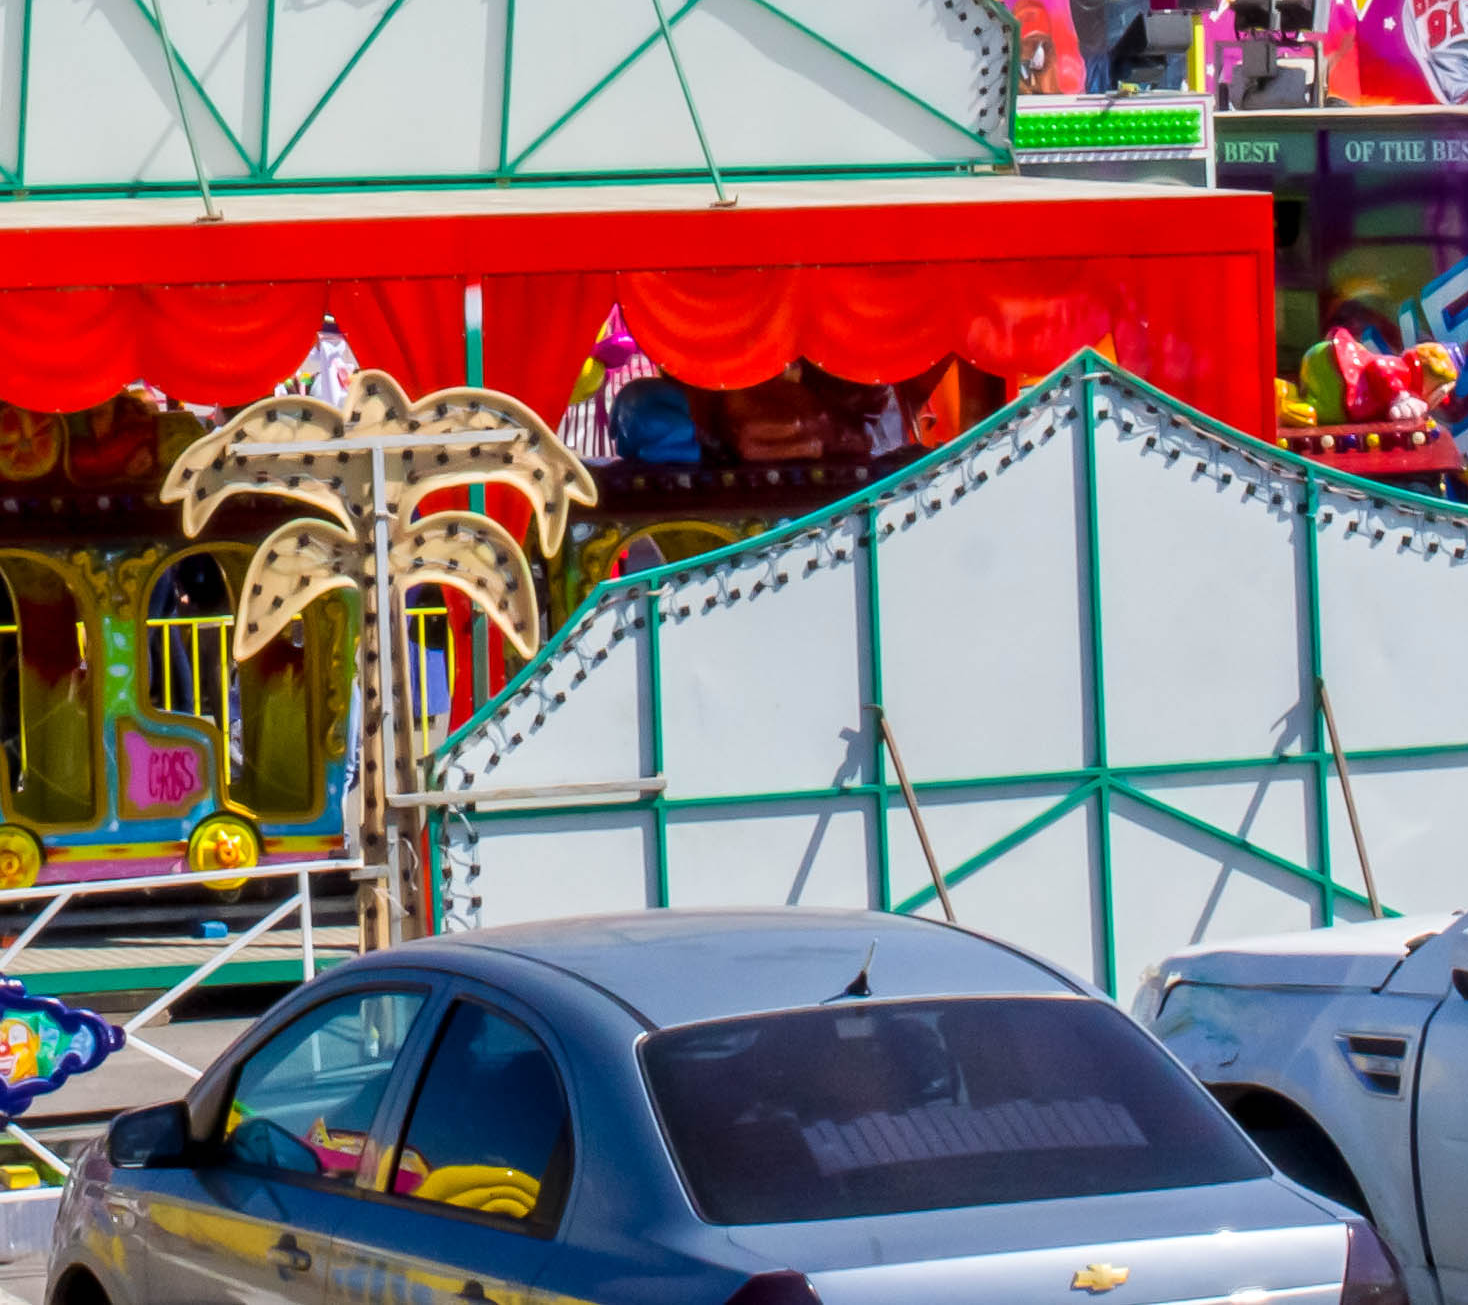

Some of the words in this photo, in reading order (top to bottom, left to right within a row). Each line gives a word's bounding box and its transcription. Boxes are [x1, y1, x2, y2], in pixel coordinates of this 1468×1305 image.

[1427, 0, 1465, 50] 91
[1224, 140, 1280, 164] BEST
[1344, 140, 1374, 164] OF
[1379, 140, 1427, 163] THE
